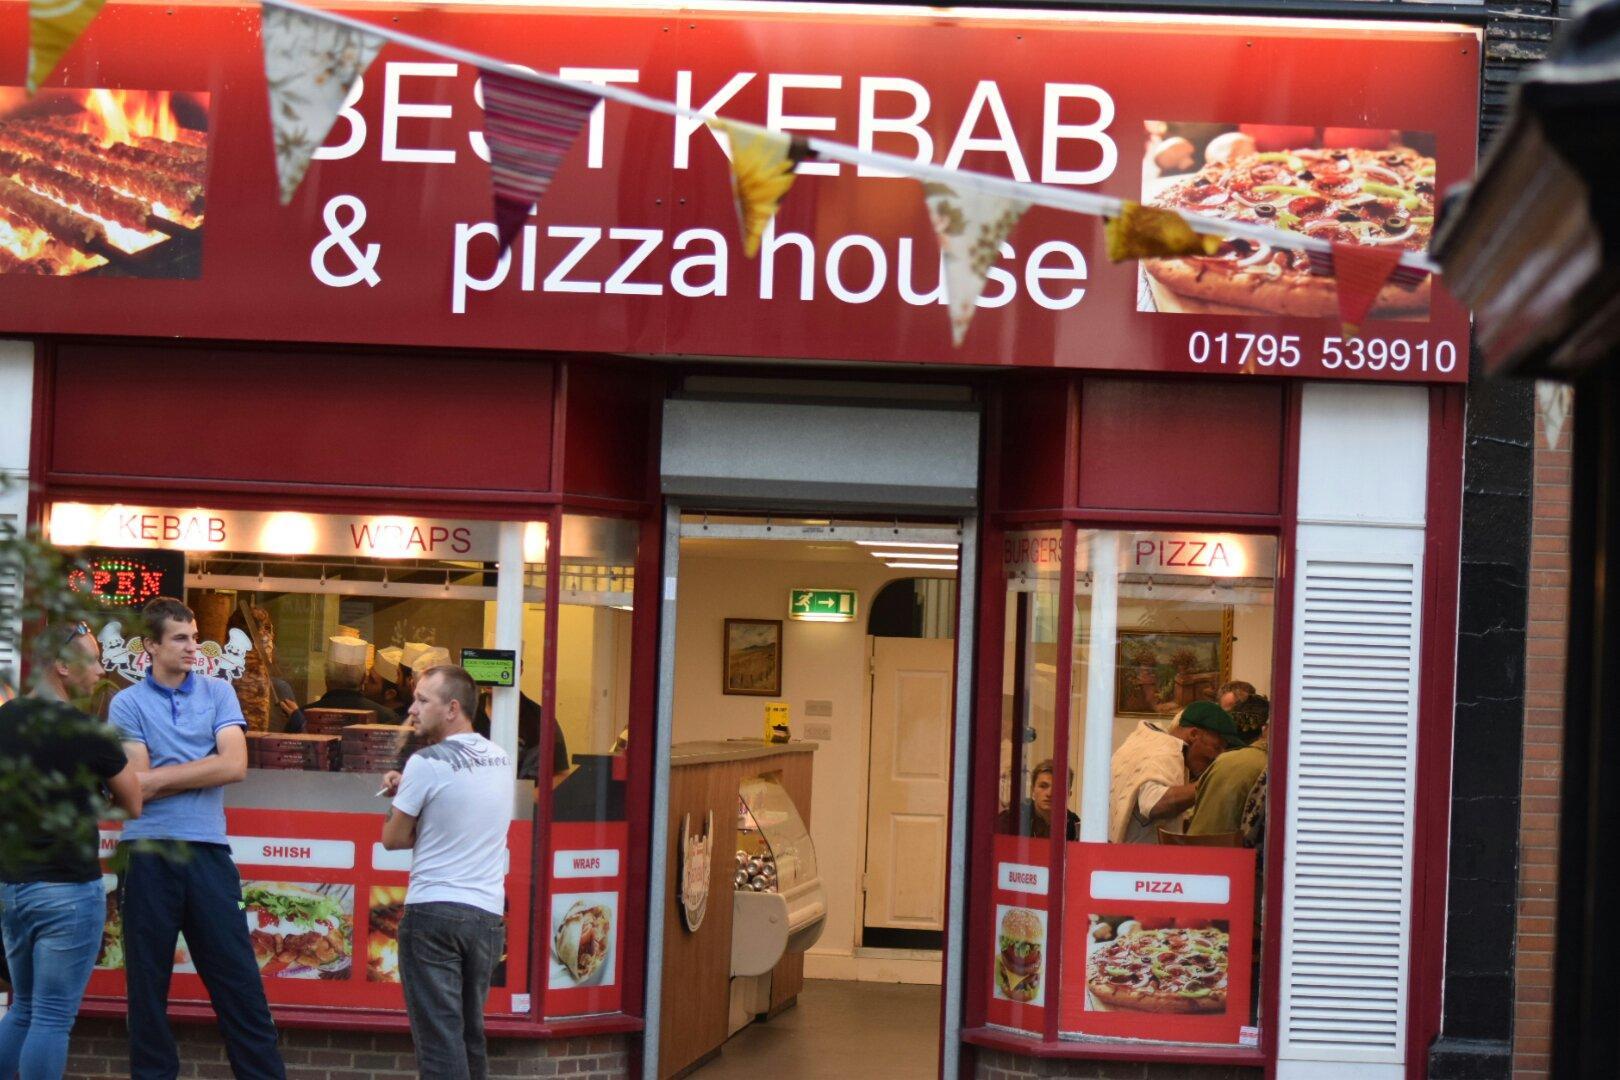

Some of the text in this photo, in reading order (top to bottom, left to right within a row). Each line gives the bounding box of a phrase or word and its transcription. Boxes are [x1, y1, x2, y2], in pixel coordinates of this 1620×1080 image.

[672, 70, 1119, 185] KEBAB
[310, 194, 1088, 314] & pizza house
[1188, 331, 1457, 373] 01795 539910
[119, 513, 226, 543] KEBAB
[1135, 539, 1230, 568] PIZZA
[262, 844, 312, 860] SHISH
[572, 858, 601, 870] WRAPS
[1008, 871, 1038, 886] BURGERS
[1134, 880, 1184, 894] PIZZA
